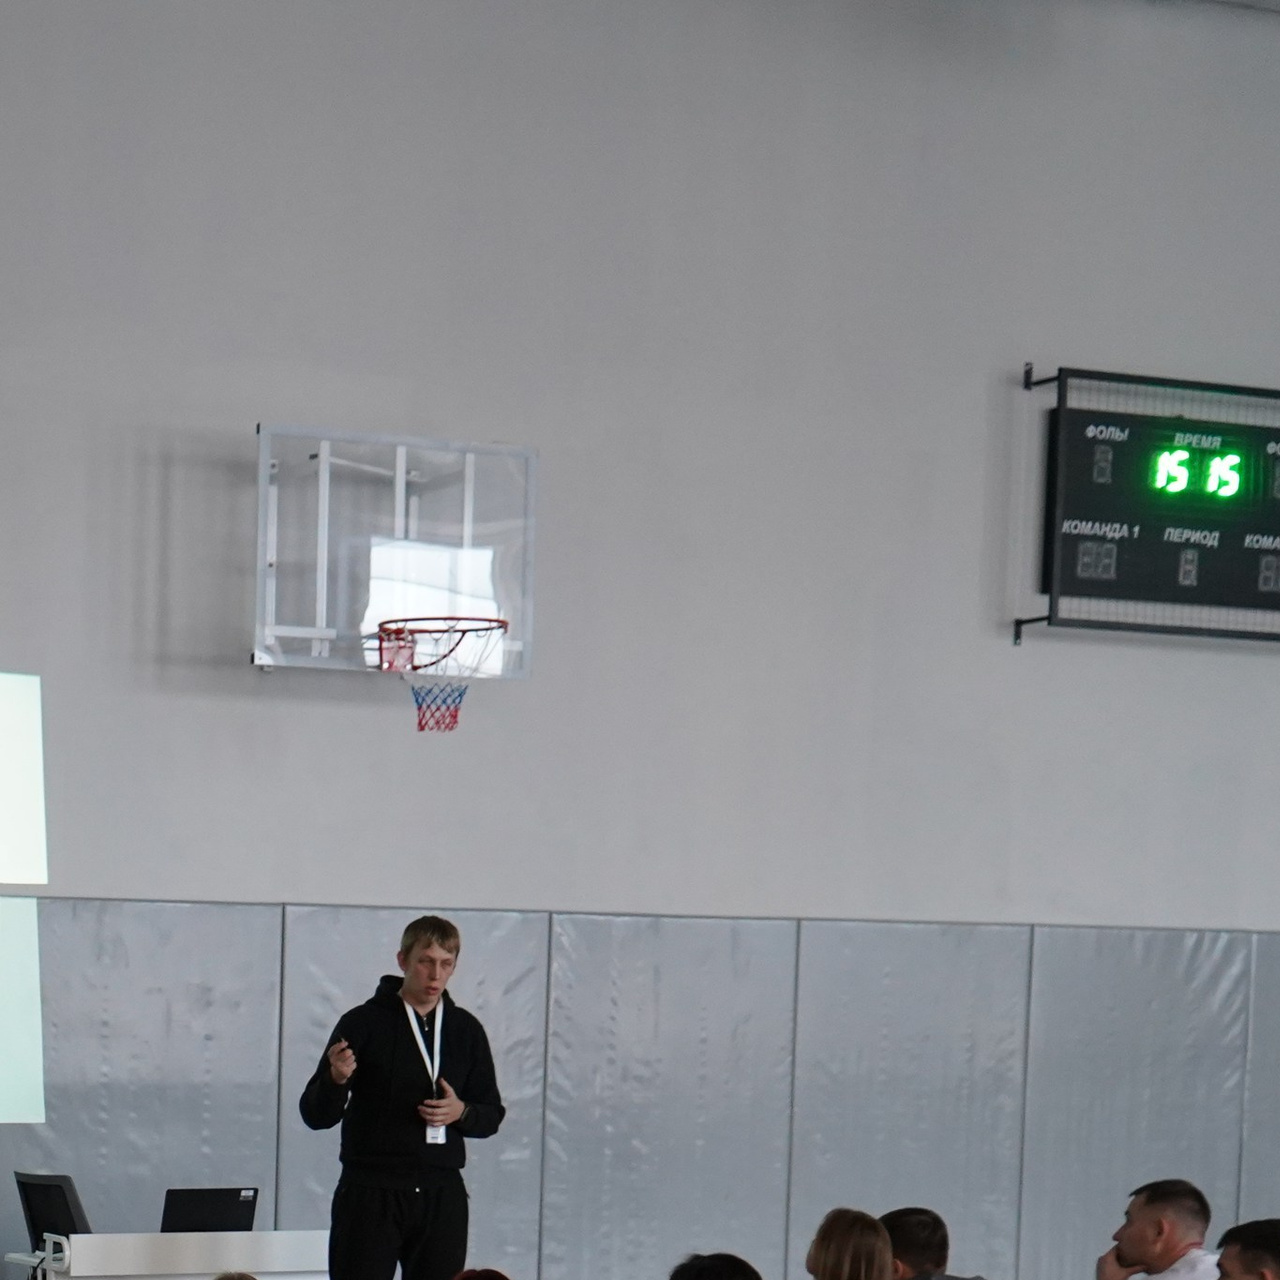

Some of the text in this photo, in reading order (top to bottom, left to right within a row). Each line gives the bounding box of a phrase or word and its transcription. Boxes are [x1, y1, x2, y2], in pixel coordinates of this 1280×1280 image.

[1085, 424, 1129, 441] ФОЛЫ
[1174, 432, 1222, 449] ВРЕМЯ
[1154, 450, 1241, 497] 15 15
[1062, 519, 1140, 540] КОМАНДА 1
[1163, 527, 1220, 548] ПЕРИОД
